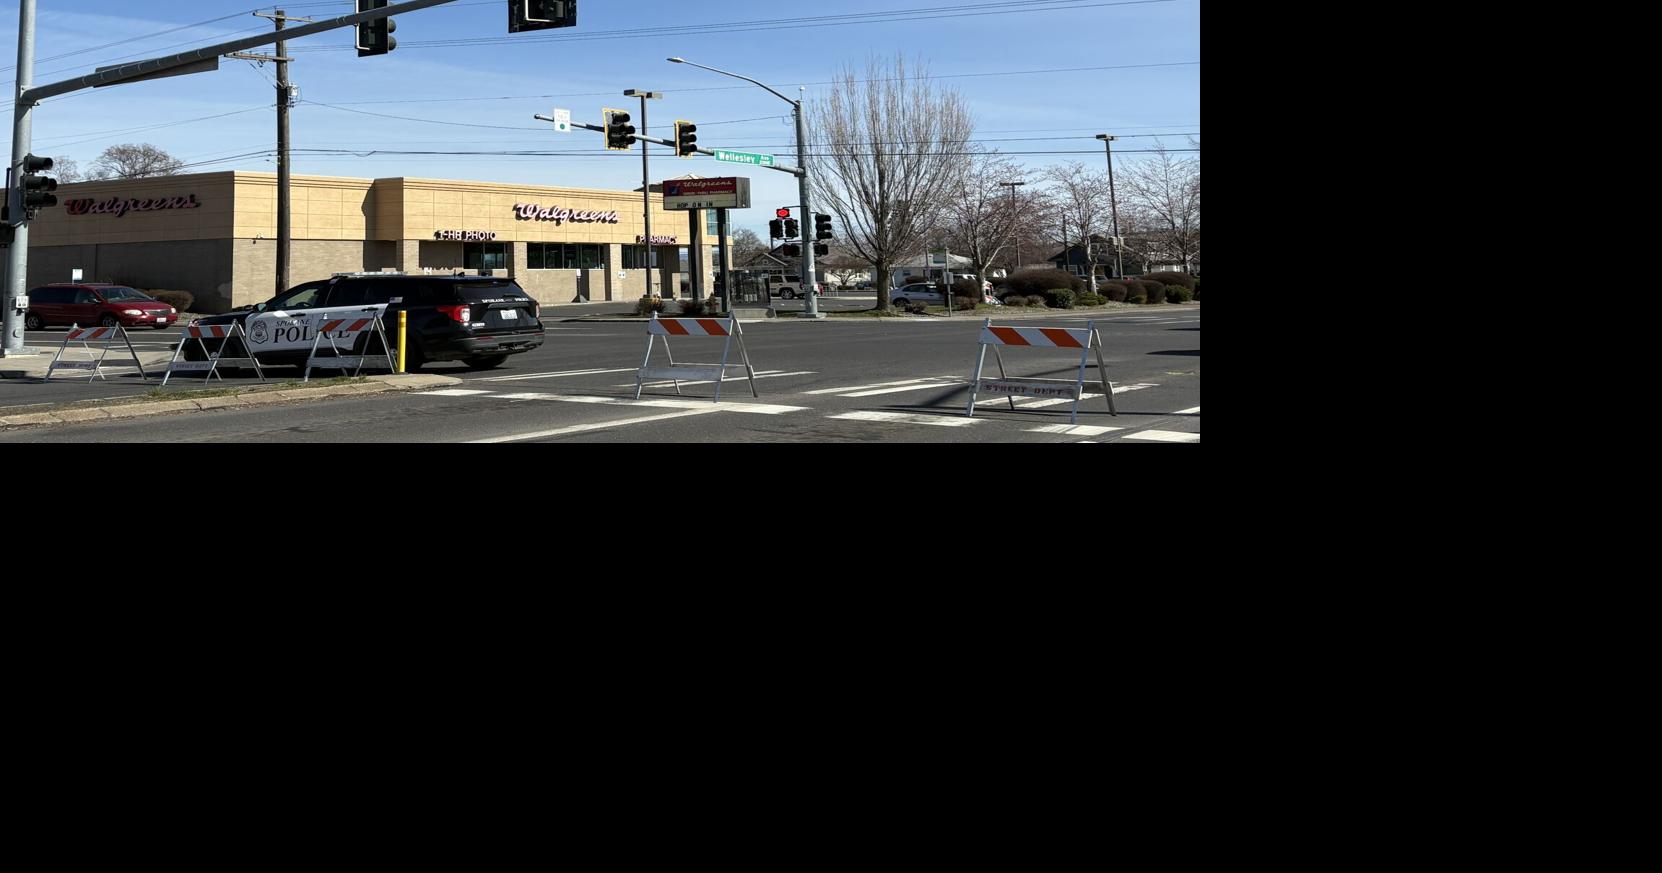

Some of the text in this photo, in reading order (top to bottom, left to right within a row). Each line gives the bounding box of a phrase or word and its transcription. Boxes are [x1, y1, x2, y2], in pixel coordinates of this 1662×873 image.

[719, 151, 755, 164] Wellesley
[64, 195, 199, 217] Walgreens
[515, 202, 619, 224] Walgreens
[465, 229, 497, 240] PHOTO
[639, 234, 677, 245] PARMAC
[276, 319, 309, 328] SPOKNE
[273, 325, 350, 343] POLCE
[985, 384, 1027, 393] STREET
